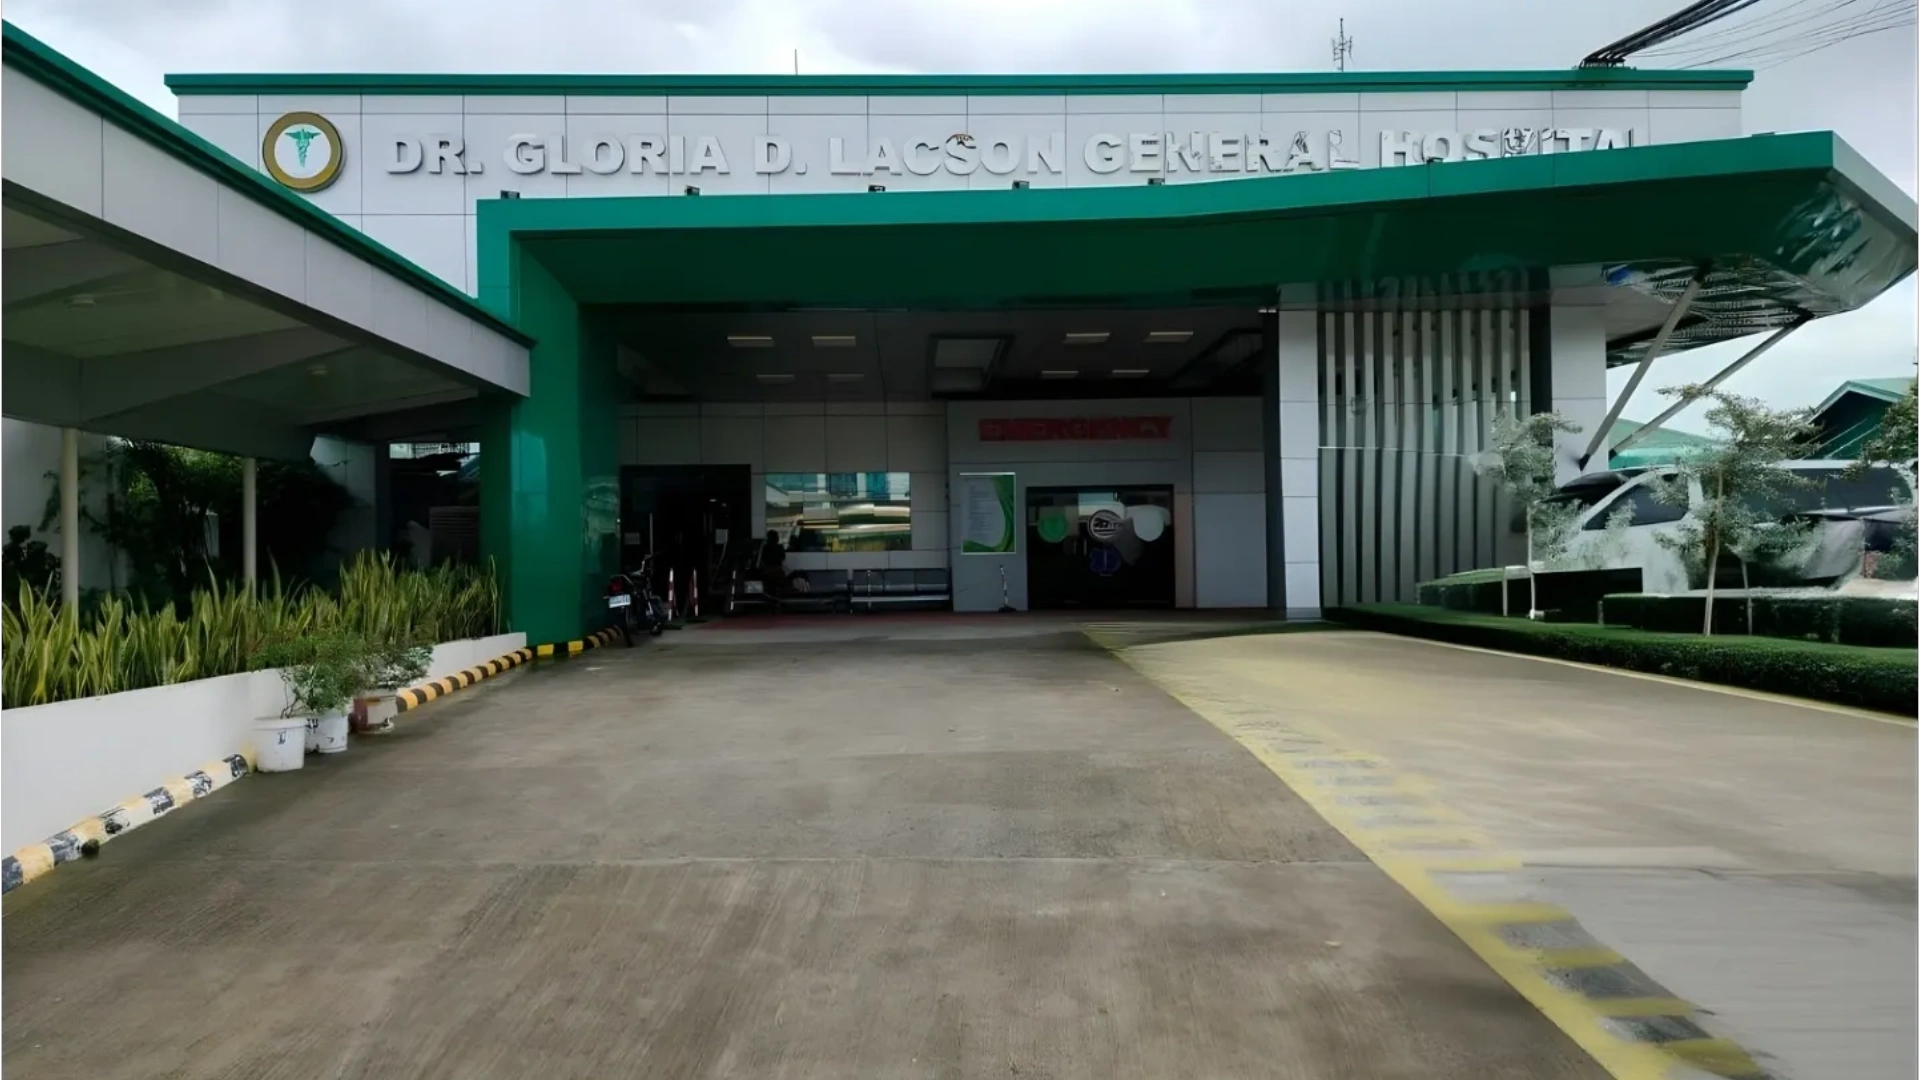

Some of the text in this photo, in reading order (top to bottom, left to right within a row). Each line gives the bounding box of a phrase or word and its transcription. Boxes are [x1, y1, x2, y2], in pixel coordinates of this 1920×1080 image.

[386, 134, 484, 175] DR.
[504, 133, 730, 175] GLORIA
[754, 134, 808, 175] D.
[828, 132, 1064, 176] LACSON
[1085, 130, 1360, 174] GENERAL
